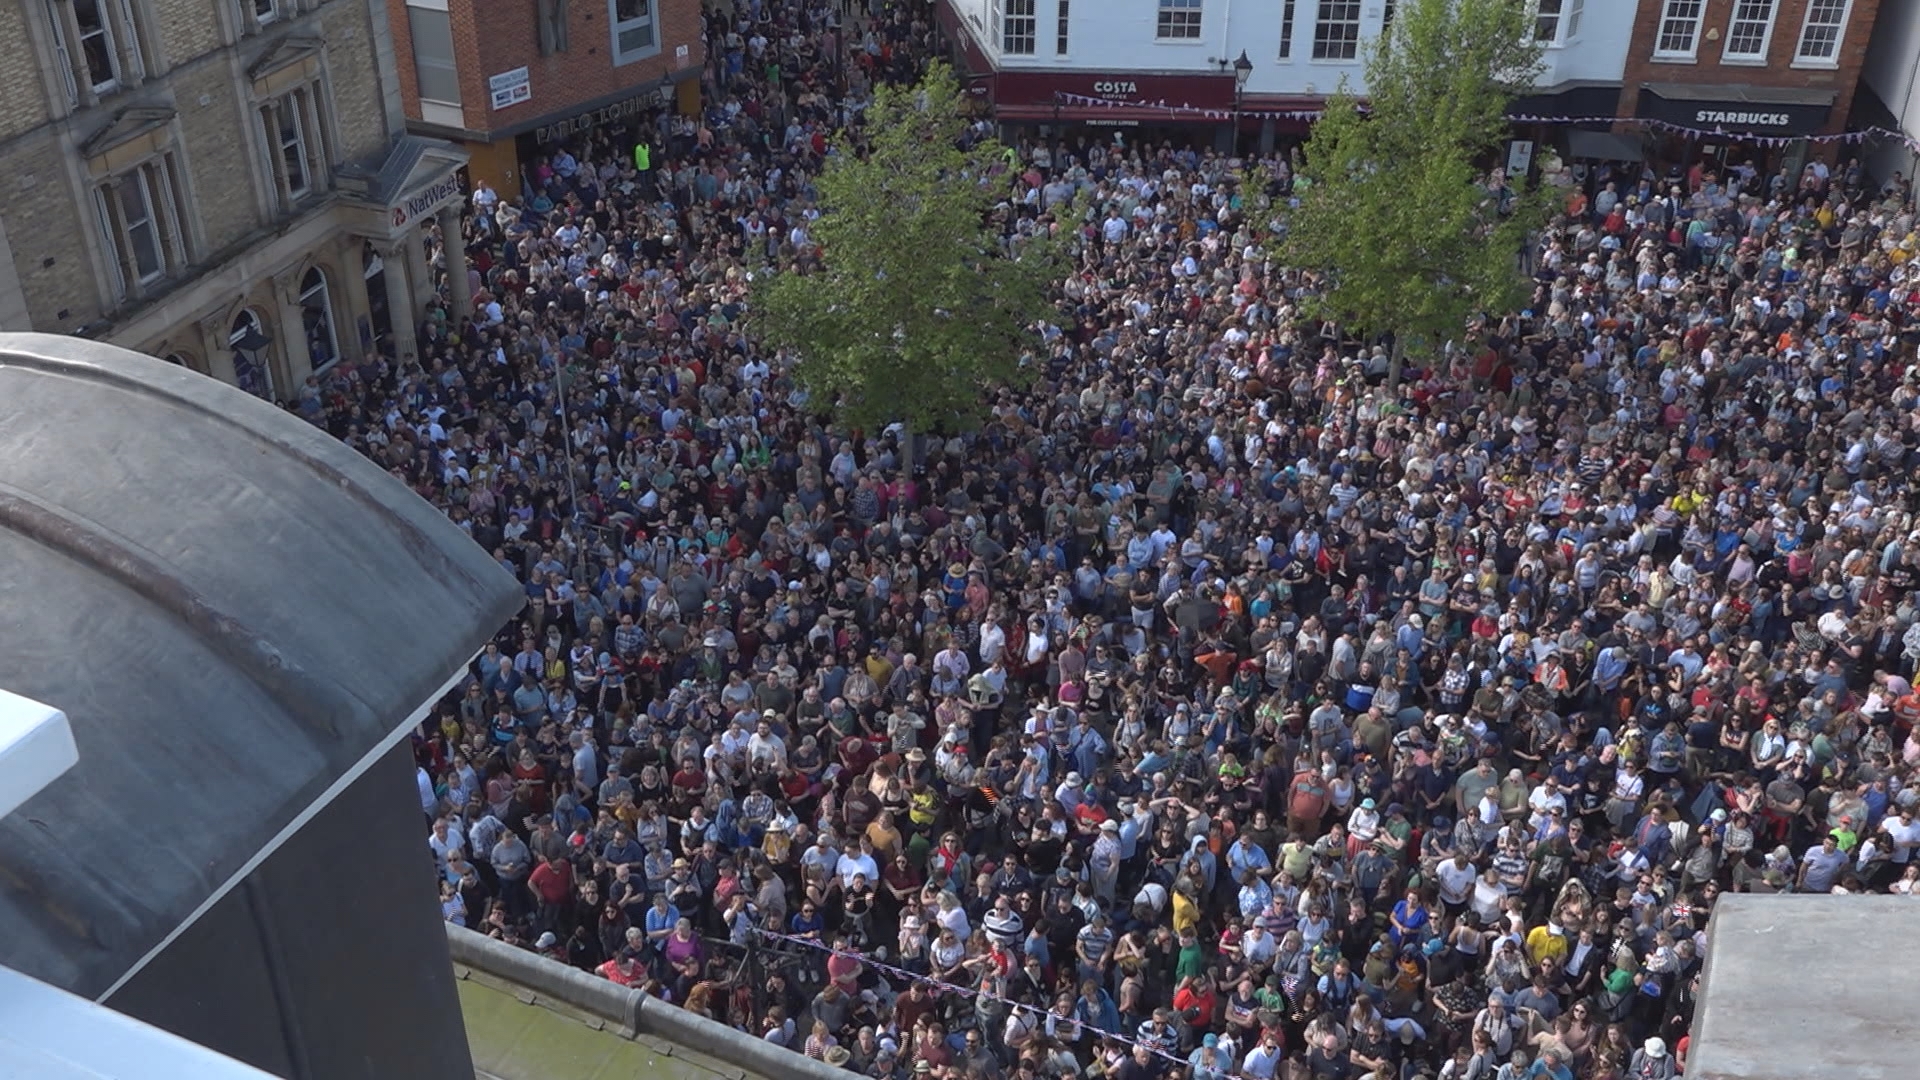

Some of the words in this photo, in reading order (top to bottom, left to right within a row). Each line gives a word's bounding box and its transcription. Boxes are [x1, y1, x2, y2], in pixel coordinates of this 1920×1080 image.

[1094, 81, 1137, 94] COSTA
[1696, 110, 1789, 126] STARBUCKS
[408, 173, 458, 219] NatWest
